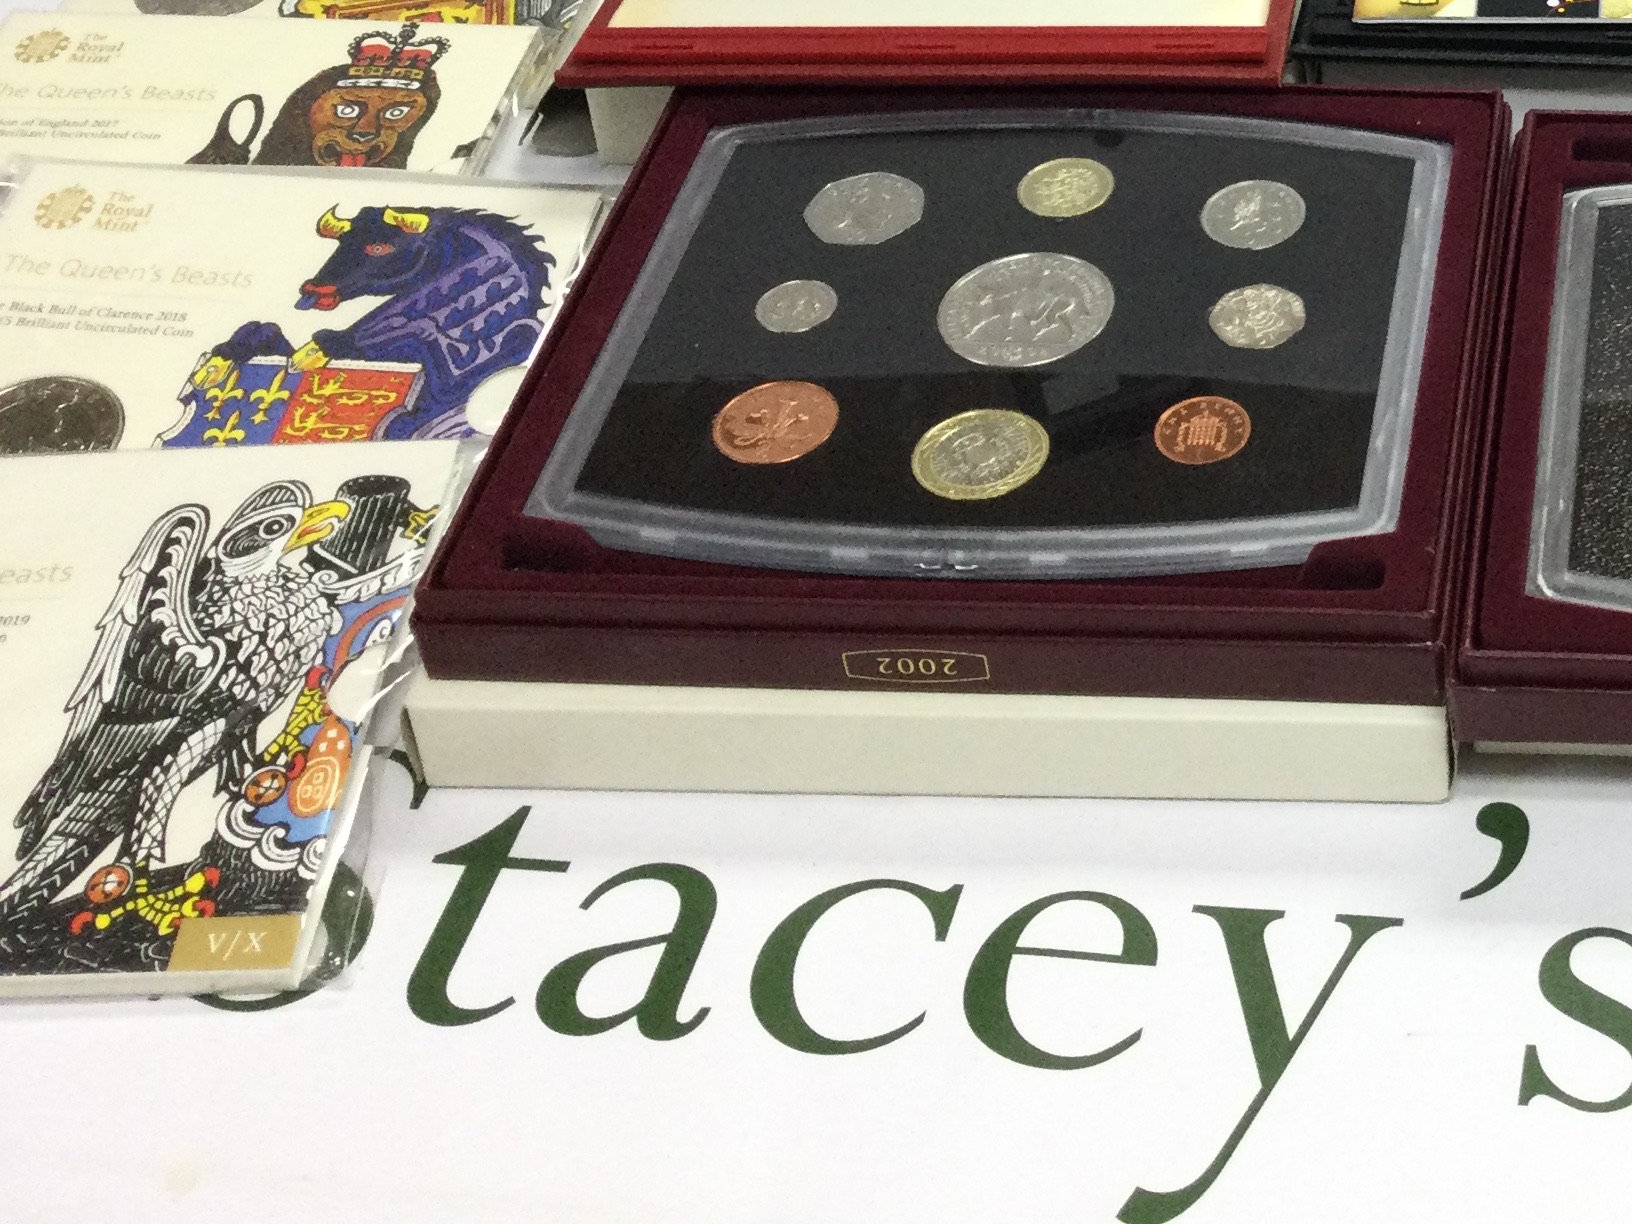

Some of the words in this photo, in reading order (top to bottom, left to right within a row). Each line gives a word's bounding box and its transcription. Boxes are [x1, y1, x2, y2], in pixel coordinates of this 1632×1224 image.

[37, 83, 134, 100] Queen's
[140, 84, 217, 102] Beasts
[101, 202, 155, 219] Royal
[93, 217, 139, 233] Mint
[4, 253, 52, 276] The
[59, 258, 165, 283] Queen's
[171, 265, 254, 289] Beasts
[8, 300, 45, 314] Black
[48, 303, 78, 316] Bull
[96, 306, 154, 321] Clarence
[15, 316, 71, 331] Brilliant
[74, 319, 159, 337] Uncirculated
[161, 325, 195, 339] Coin
[875, 656, 959, 676] 2002
